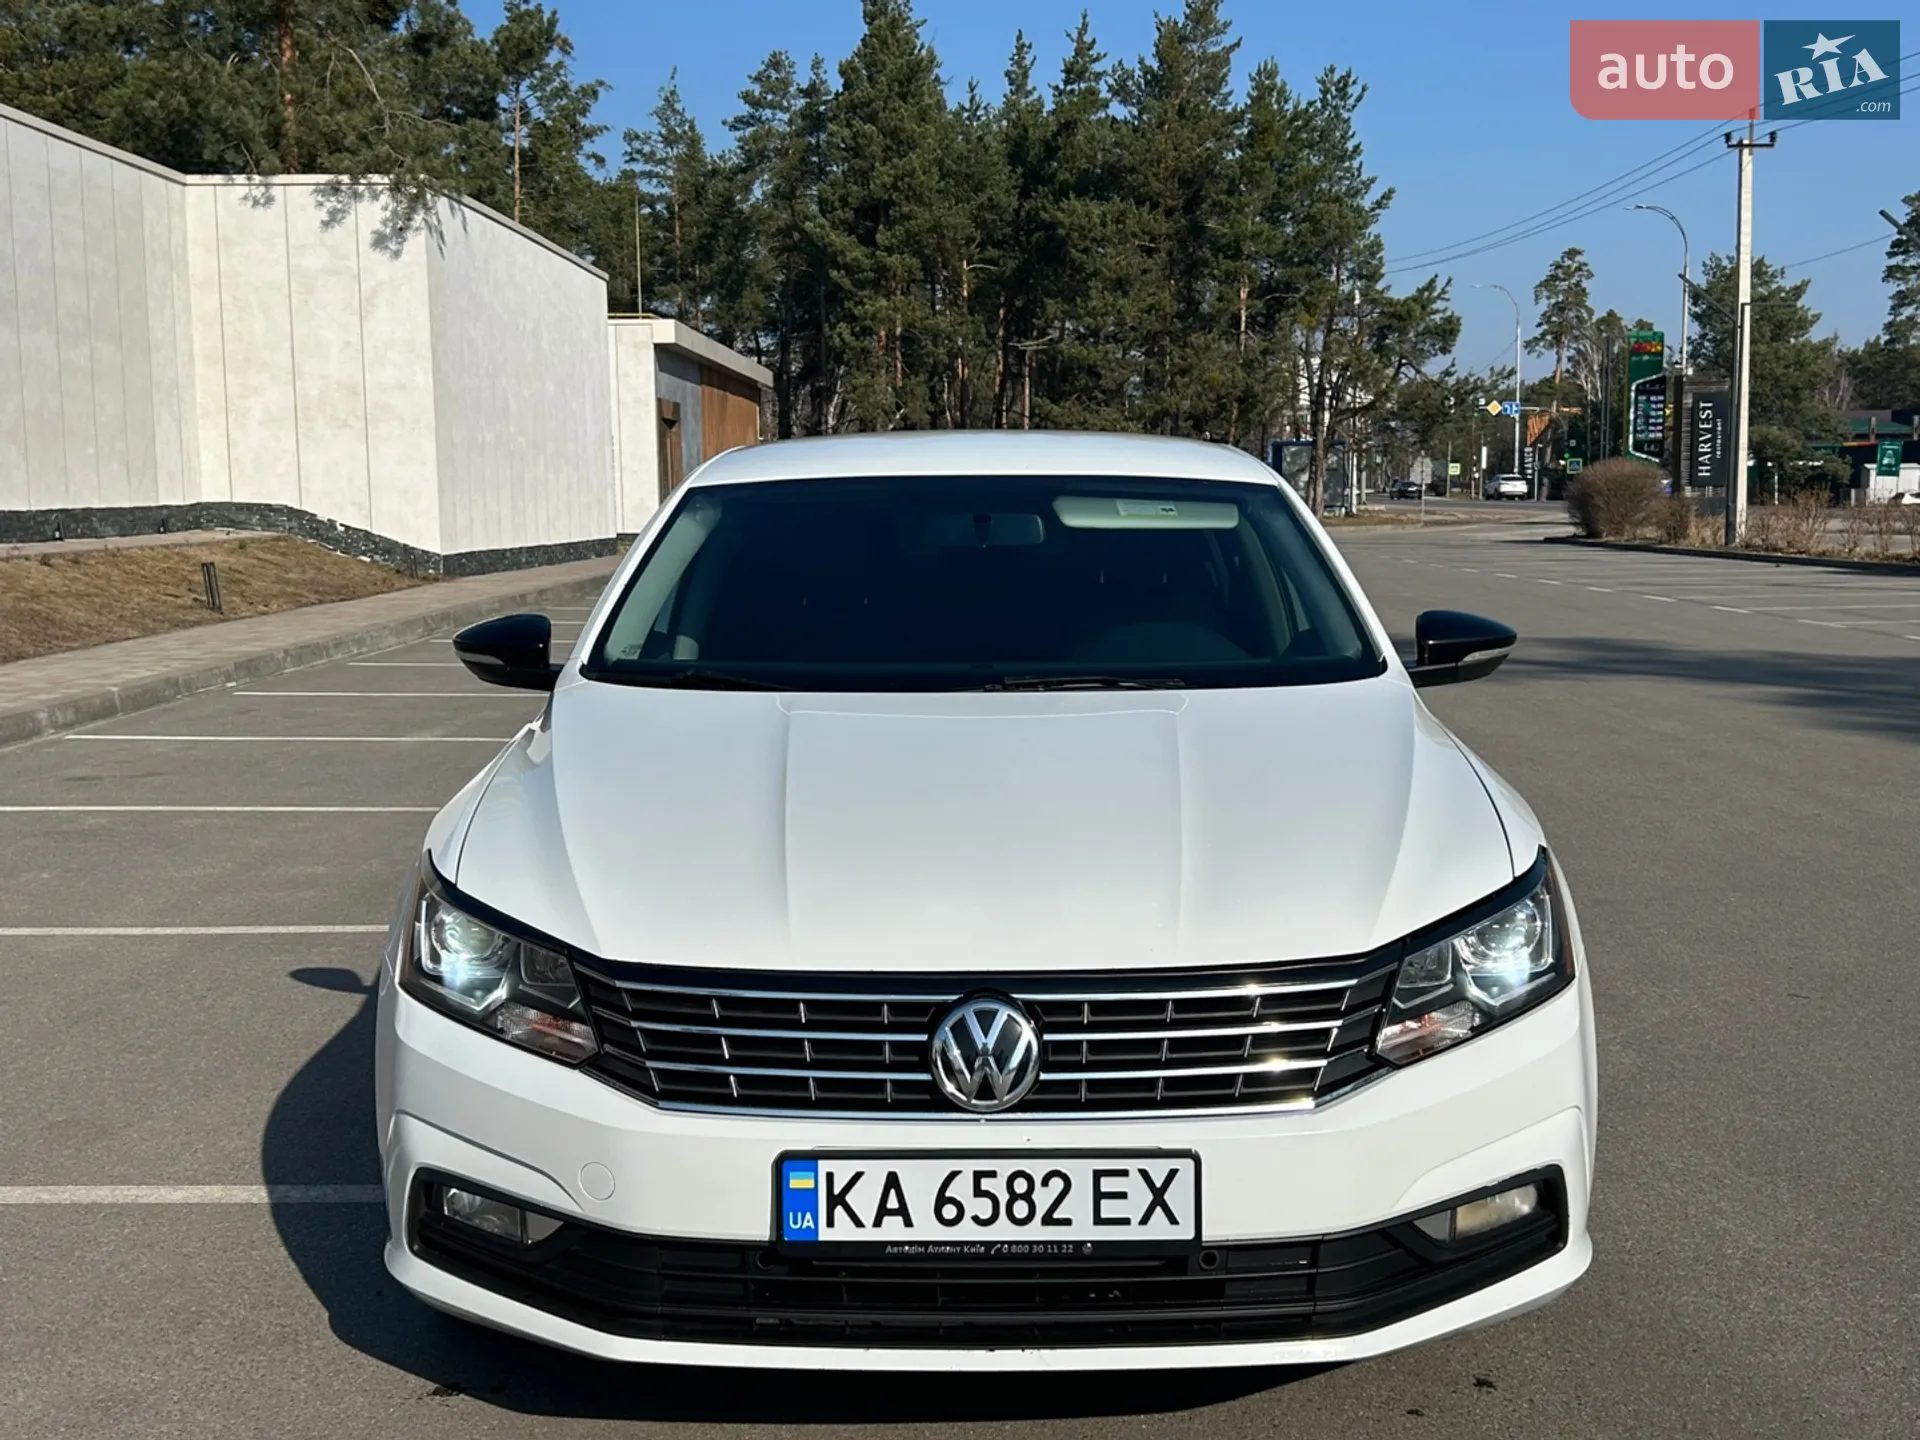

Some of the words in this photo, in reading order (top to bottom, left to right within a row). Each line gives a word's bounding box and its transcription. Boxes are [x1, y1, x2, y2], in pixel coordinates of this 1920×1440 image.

[1697, 400, 1714, 477] HARVEST
[789, 1211, 815, 1230] UA
[825, 1170, 915, 1229] KA
[933, 1169, 1073, 1228] 6582
[1092, 1167, 1180, 1227] EX
